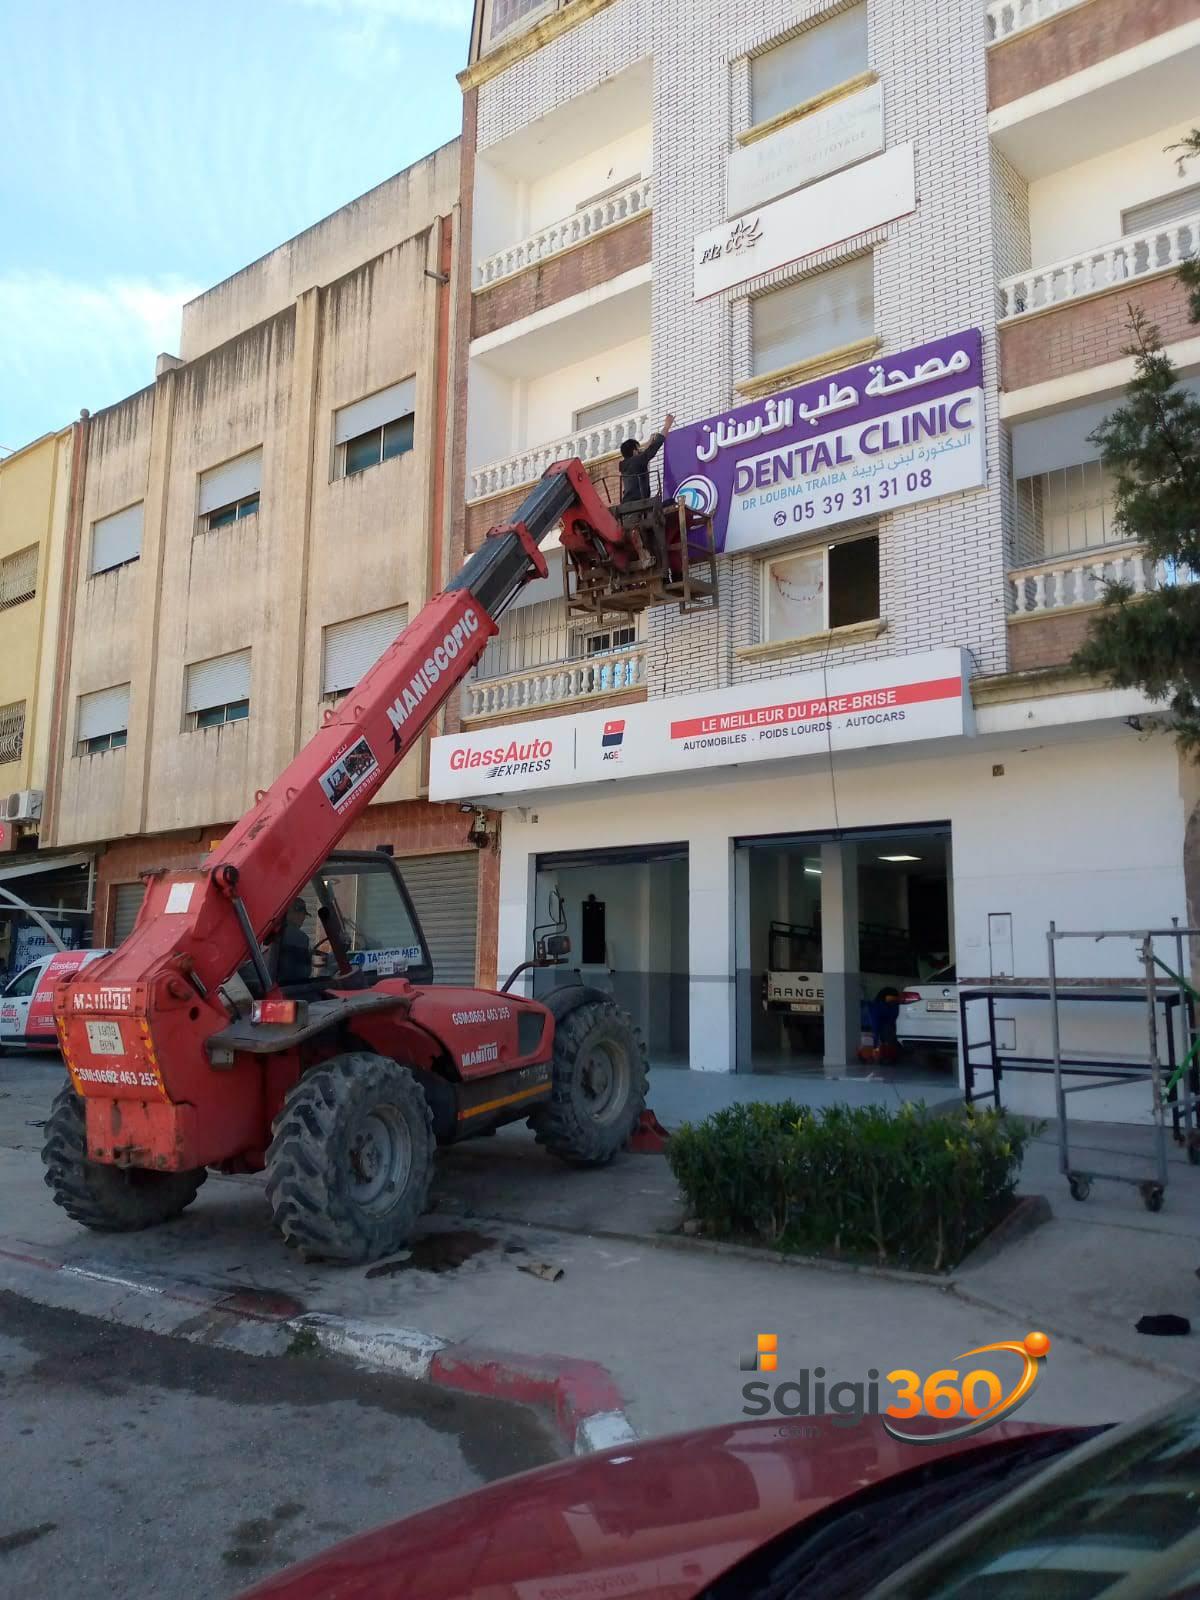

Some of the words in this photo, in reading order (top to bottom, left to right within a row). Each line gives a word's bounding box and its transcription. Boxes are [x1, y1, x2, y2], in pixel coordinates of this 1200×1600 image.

[864, 349, 971, 398] مصحة
[798, 383, 859, 426] طب
[696, 396, 794, 463] الأسنان
[734, 435, 852, 496] DENTAL
[859, 397, 973, 456] CLINIC
[918, 432, 972, 461] الدكتورة
[887, 447, 915, 474] لبنى
[742, 490, 759, 512] DR
[759, 482, 804, 508] LOUBNA
[806, 472, 848, 497] TRAIBA
[792, 500, 815, 524] 05
[822, 492, 845, 516] 39
[852, 484, 872, 507] 31
[879, 476, 899, 500] 31
[906, 468, 933, 493] 08
[386, 608, 479, 731] MANISCOPIC
[683, 733, 748, 751] AUTOMOBILES
[759, 724, 789, 740] POIDS
[791, 721, 833, 736] LOURDS
[846, 711, 906, 729] AUTOCARS
[702, 719, 718, 732] LE
[720, 707, 784, 730] MEILLEUR
[787, 703, 807, 720] DU
[810, 691, 897, 717] PARE-BRISE
[450, 738, 553, 770] GlassAuto
[497, 759, 551, 778] EXPRESS
[602, 751, 619, 762] AGE
[461, 1041, 498, 1067] MANITOU
[120, 1070, 138, 1086] 463
[138, 1072, 159, 1087] 255
